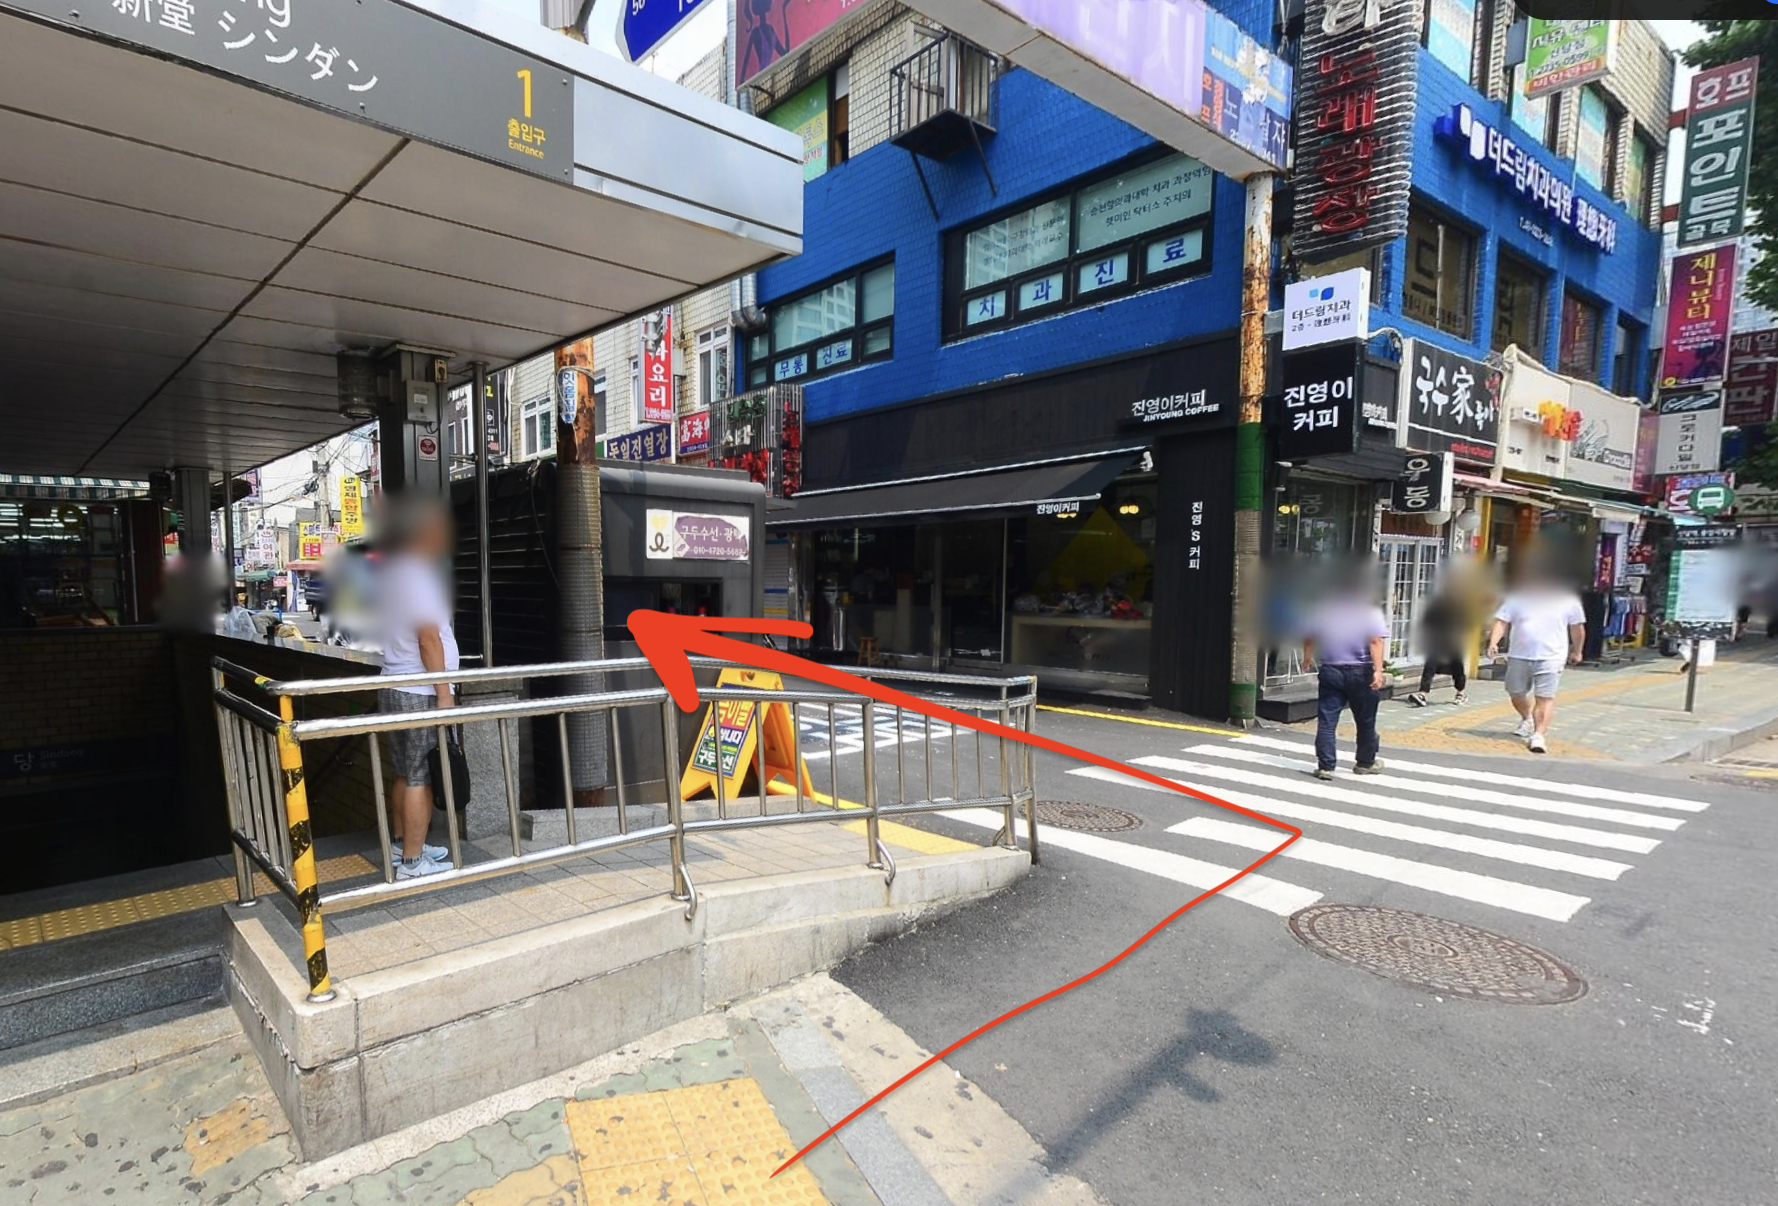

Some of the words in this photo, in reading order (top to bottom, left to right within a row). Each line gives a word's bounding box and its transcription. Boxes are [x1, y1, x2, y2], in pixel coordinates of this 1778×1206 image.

[217, 10, 379, 92] シンダン
[517, 68, 533, 118] 1
[1695, 67, 1752, 110] 호프
[508, 117, 546, 146] 출입구
[508, 138, 545, 159] Entrance
[1487, 126, 1573, 224] 더드림치과의원
[1684, 108, 1748, 225] 포인트
[1163, 187, 1193, 208] 주치의
[1686, 252, 1718, 320] 제니뷰티
[1291, 299, 1351, 321] 더드림치과
[780, 355, 804, 376] 무통
[822, 341, 848, 366] 진료
[1131, 389, 1206, 417] 진영이커피
[1284, 376, 1354, 408] 진영이
[1142, 409, 1184, 422] JINYOUNG
[1185, 403, 1220, 416] COFFEE
[1293, 405, 1340, 433] 커피
[1404, 458, 1432, 509] 우동
[1036, 501, 1080, 515] 진영이커피
[698, 750, 734, 771] 구두선
